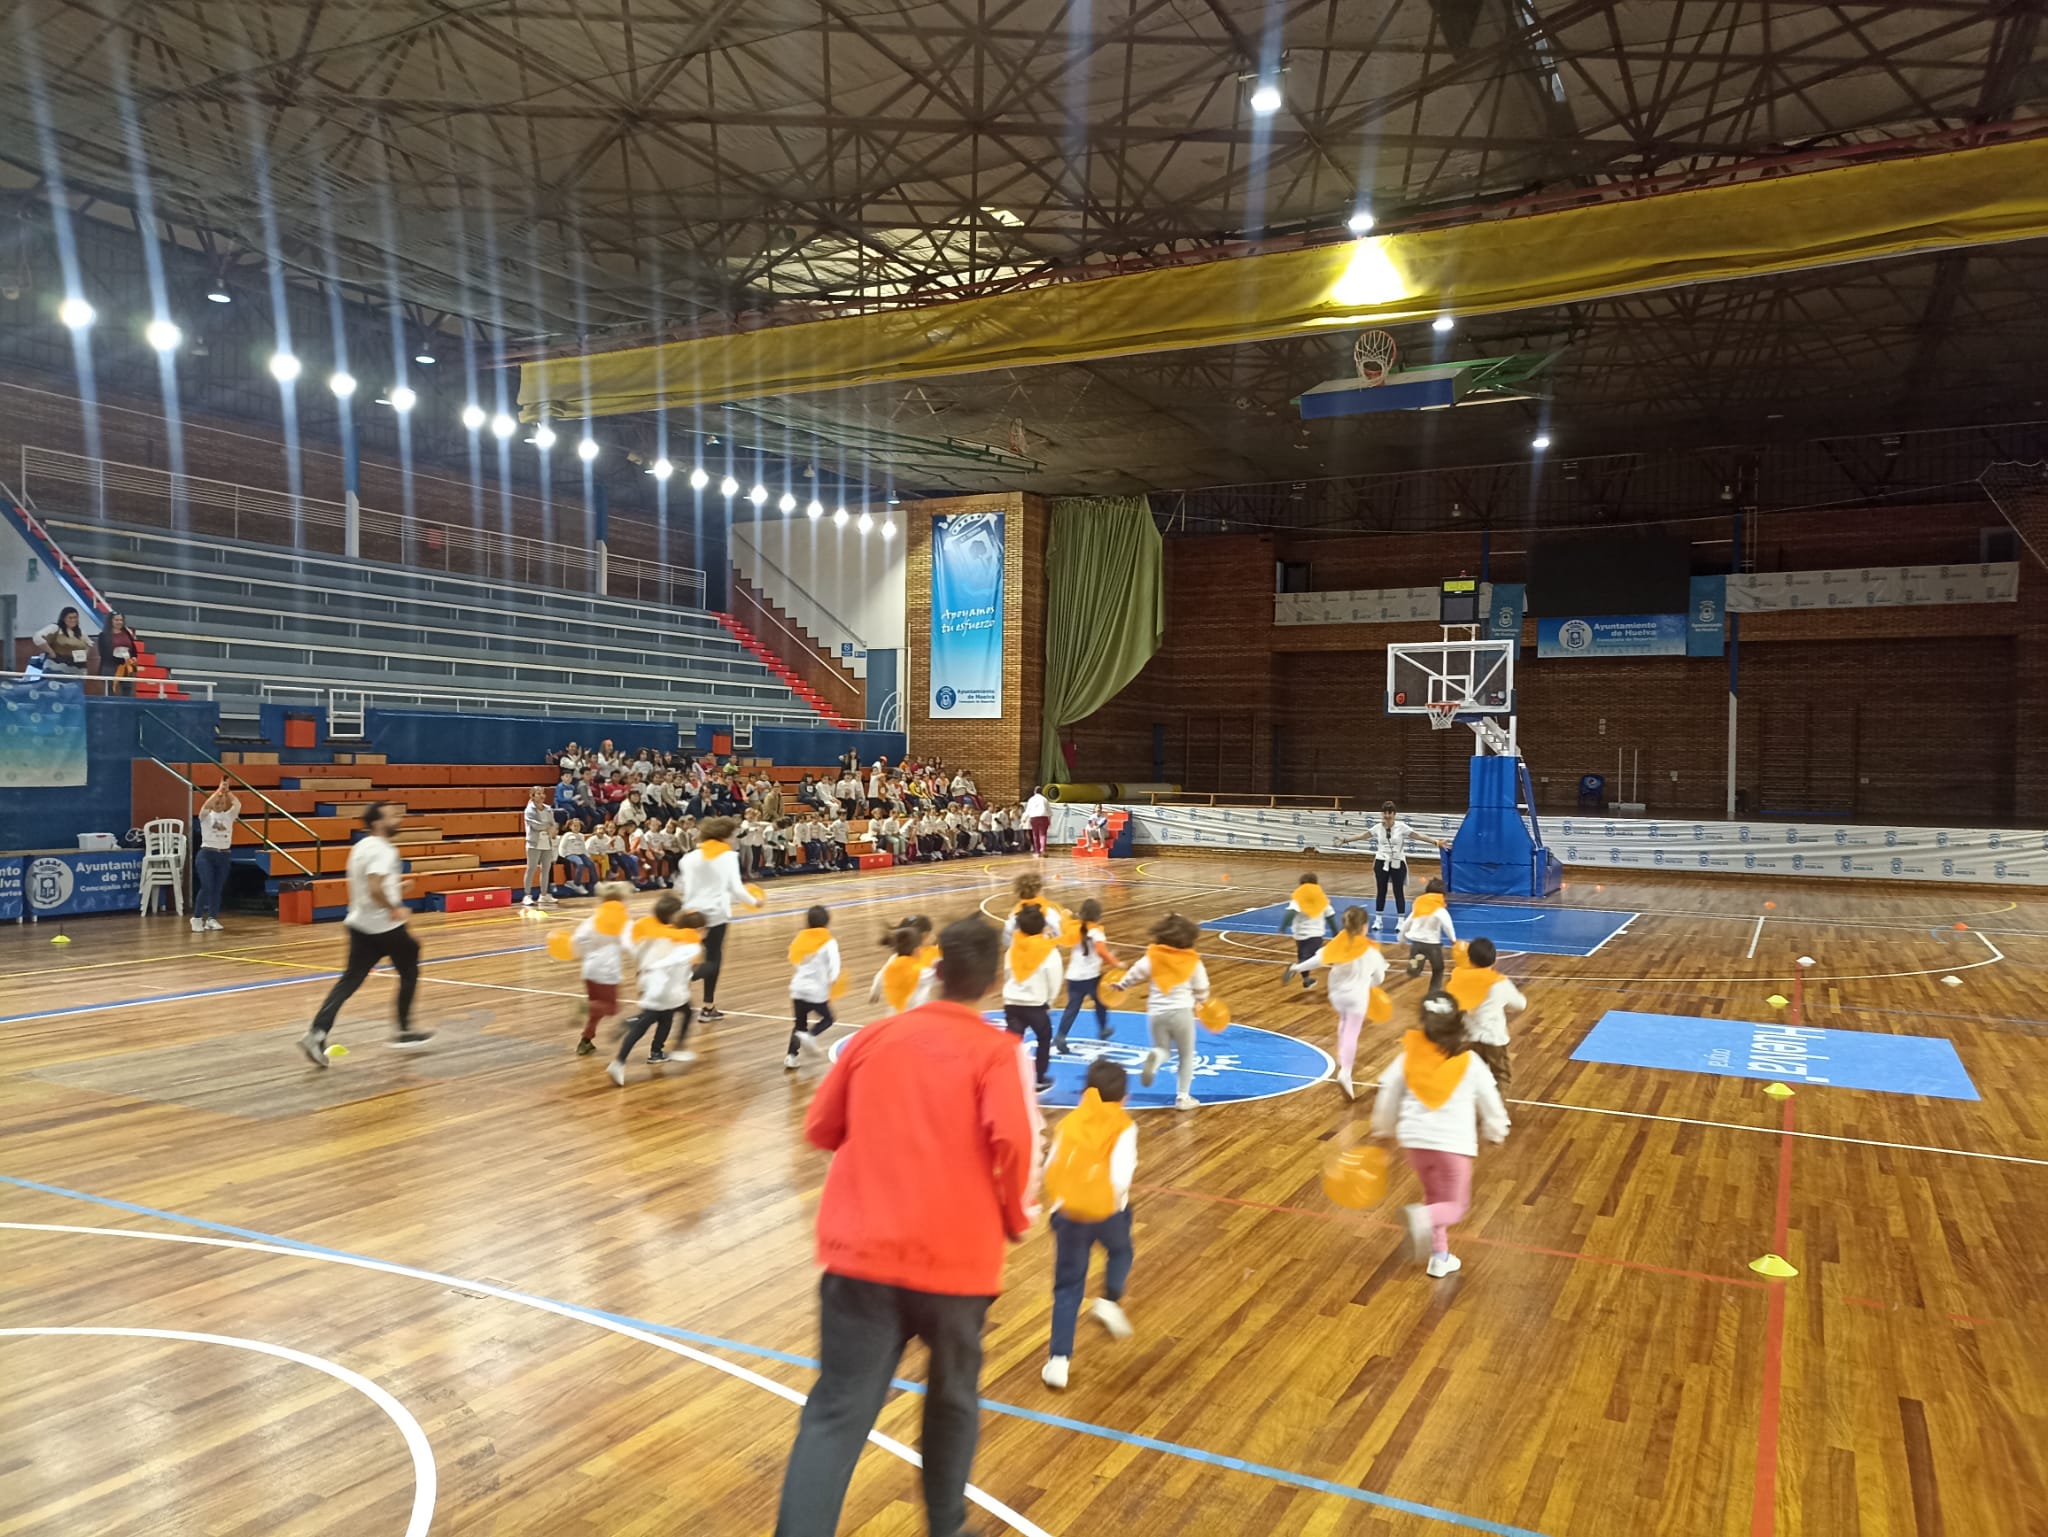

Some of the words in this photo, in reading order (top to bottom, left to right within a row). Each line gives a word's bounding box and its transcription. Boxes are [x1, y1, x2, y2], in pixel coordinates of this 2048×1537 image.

[941, 606, 995, 626] Apoyamos
[941, 623, 954, 634] tu
[955, 618, 996, 638] esfuerzo
[1593, 622, 1657, 632] Ayuntamiento
[1624, 629, 1657, 637] Huelva
[76, 860, 142, 875] Ayuntamie
[101, 872, 118, 882] de
[1747, 1023, 1830, 1077] Huelva
